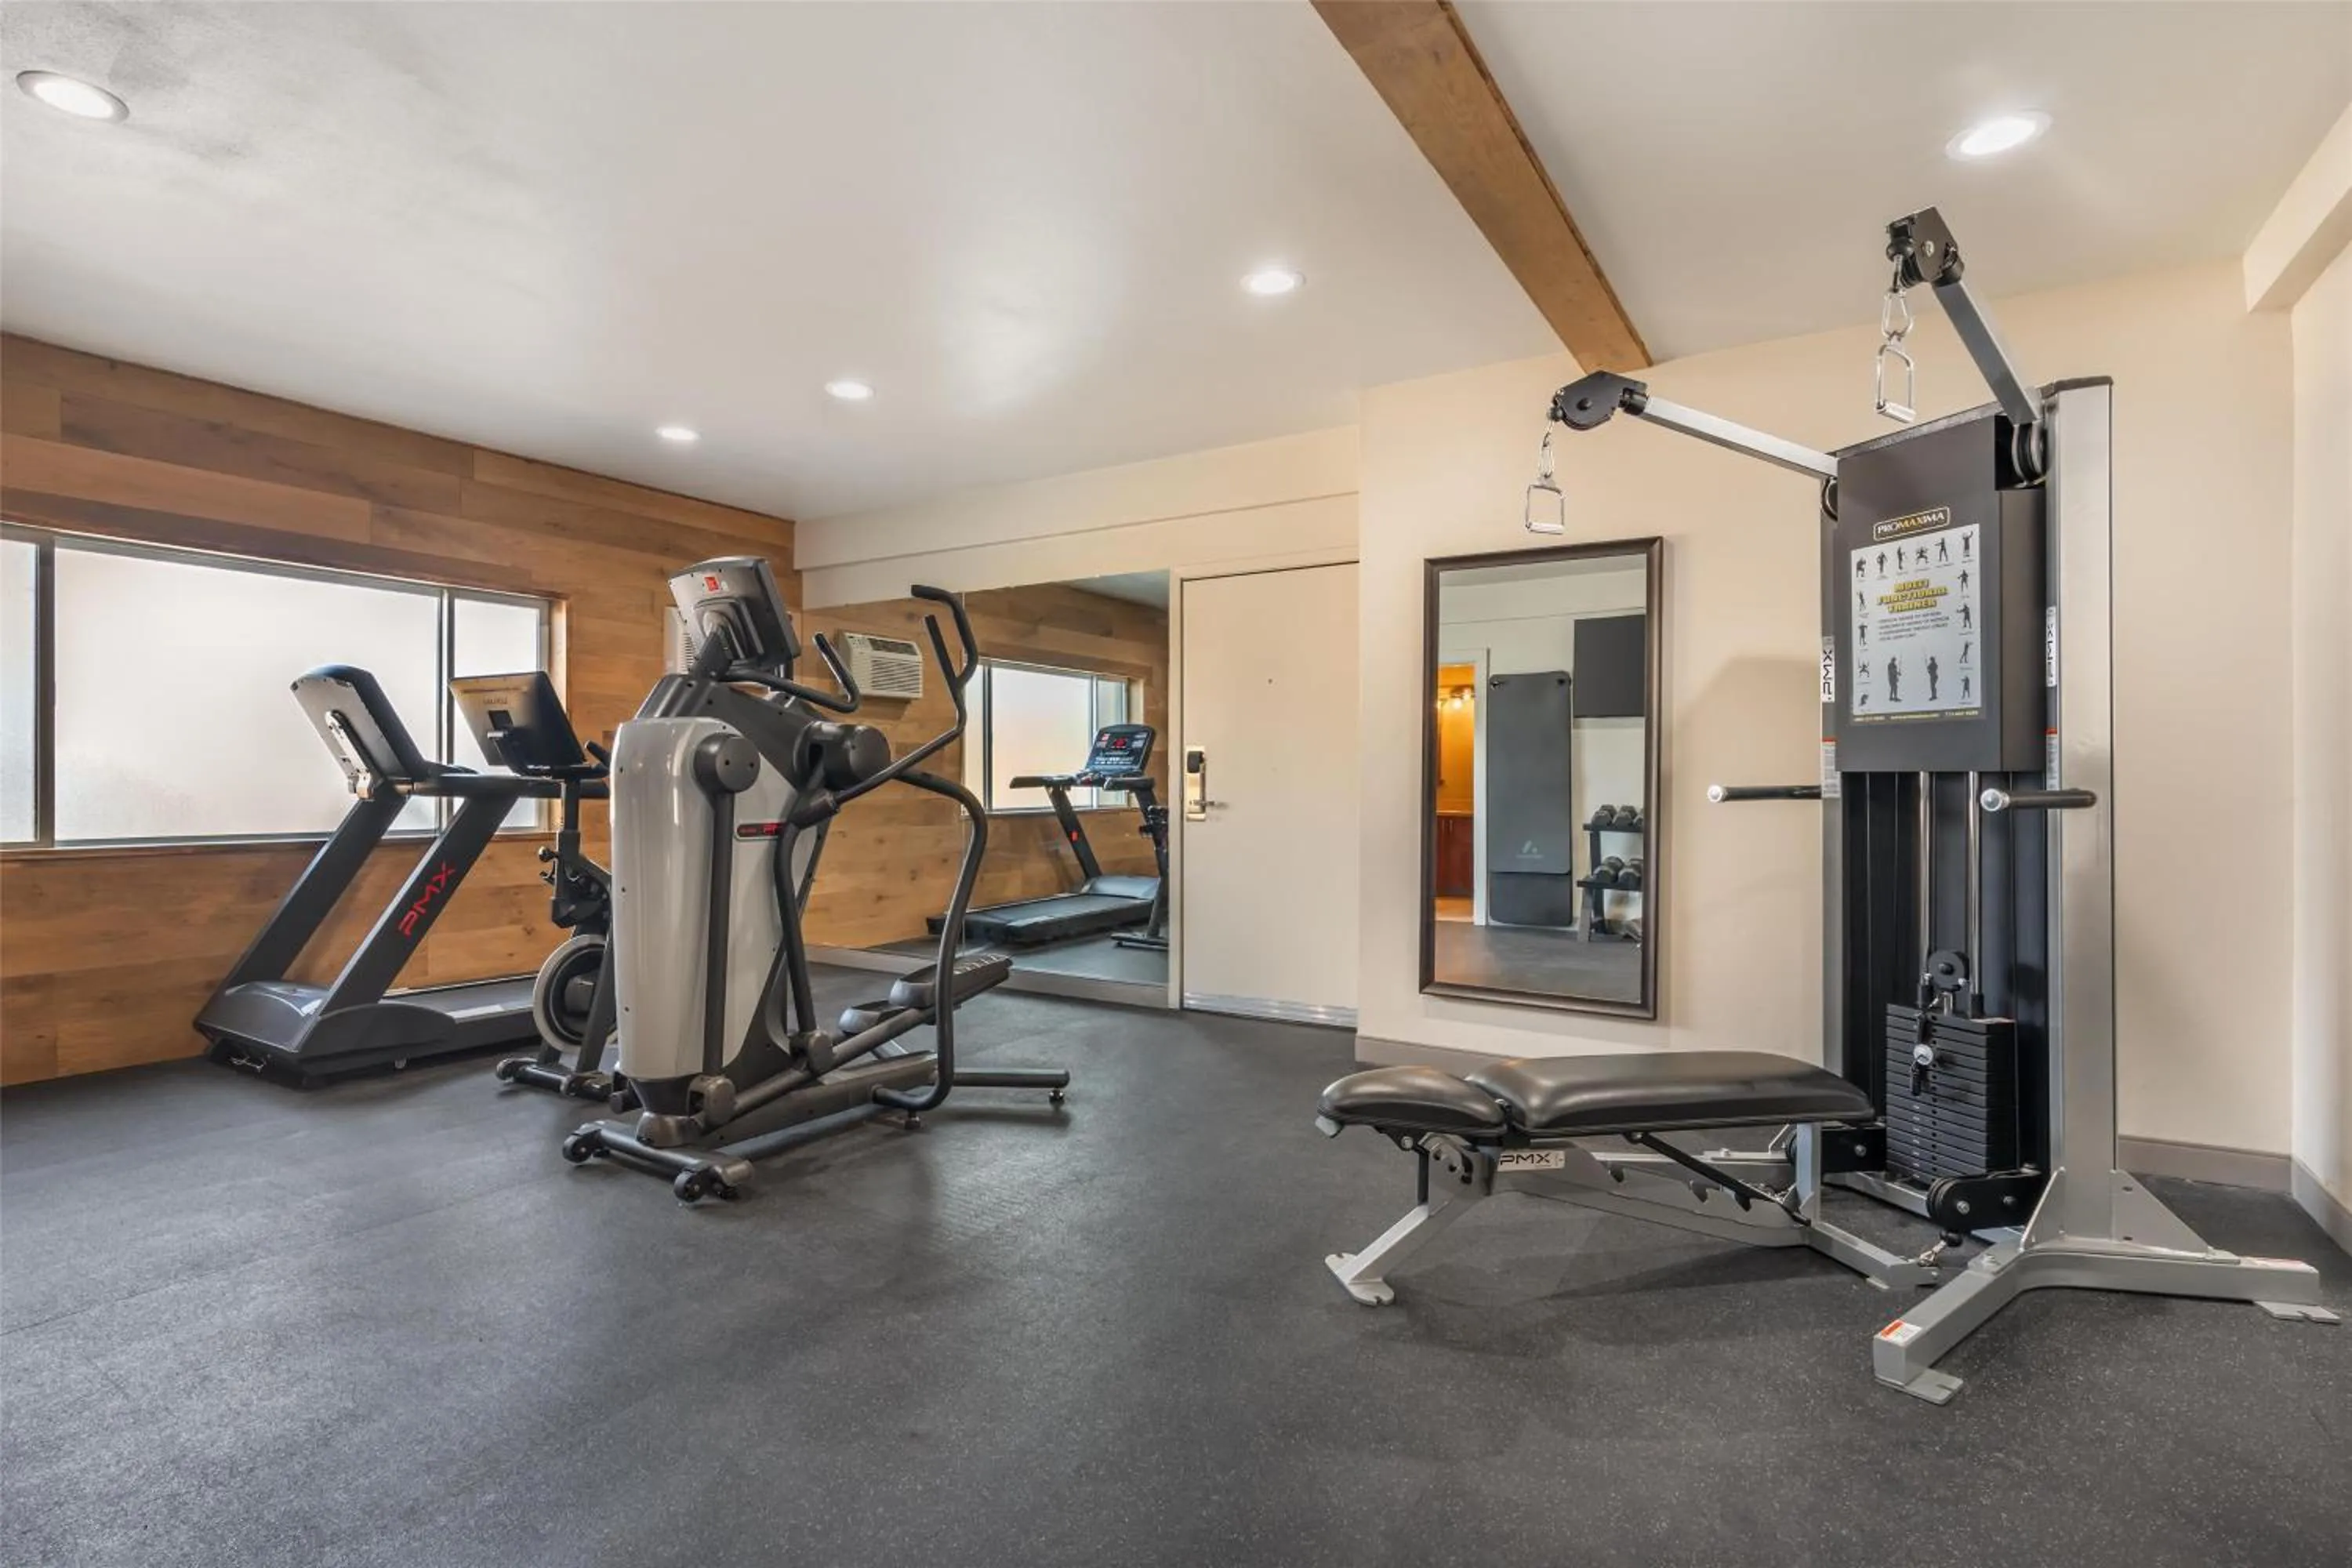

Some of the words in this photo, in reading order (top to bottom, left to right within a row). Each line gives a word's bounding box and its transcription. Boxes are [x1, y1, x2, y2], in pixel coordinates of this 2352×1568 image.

[1878, 512, 1944, 534] PROMAXIMA
[1823, 649, 1832, 695] PMX
[398, 860, 456, 937] PMX
[1500, 1152, 1551, 1167] PMX
